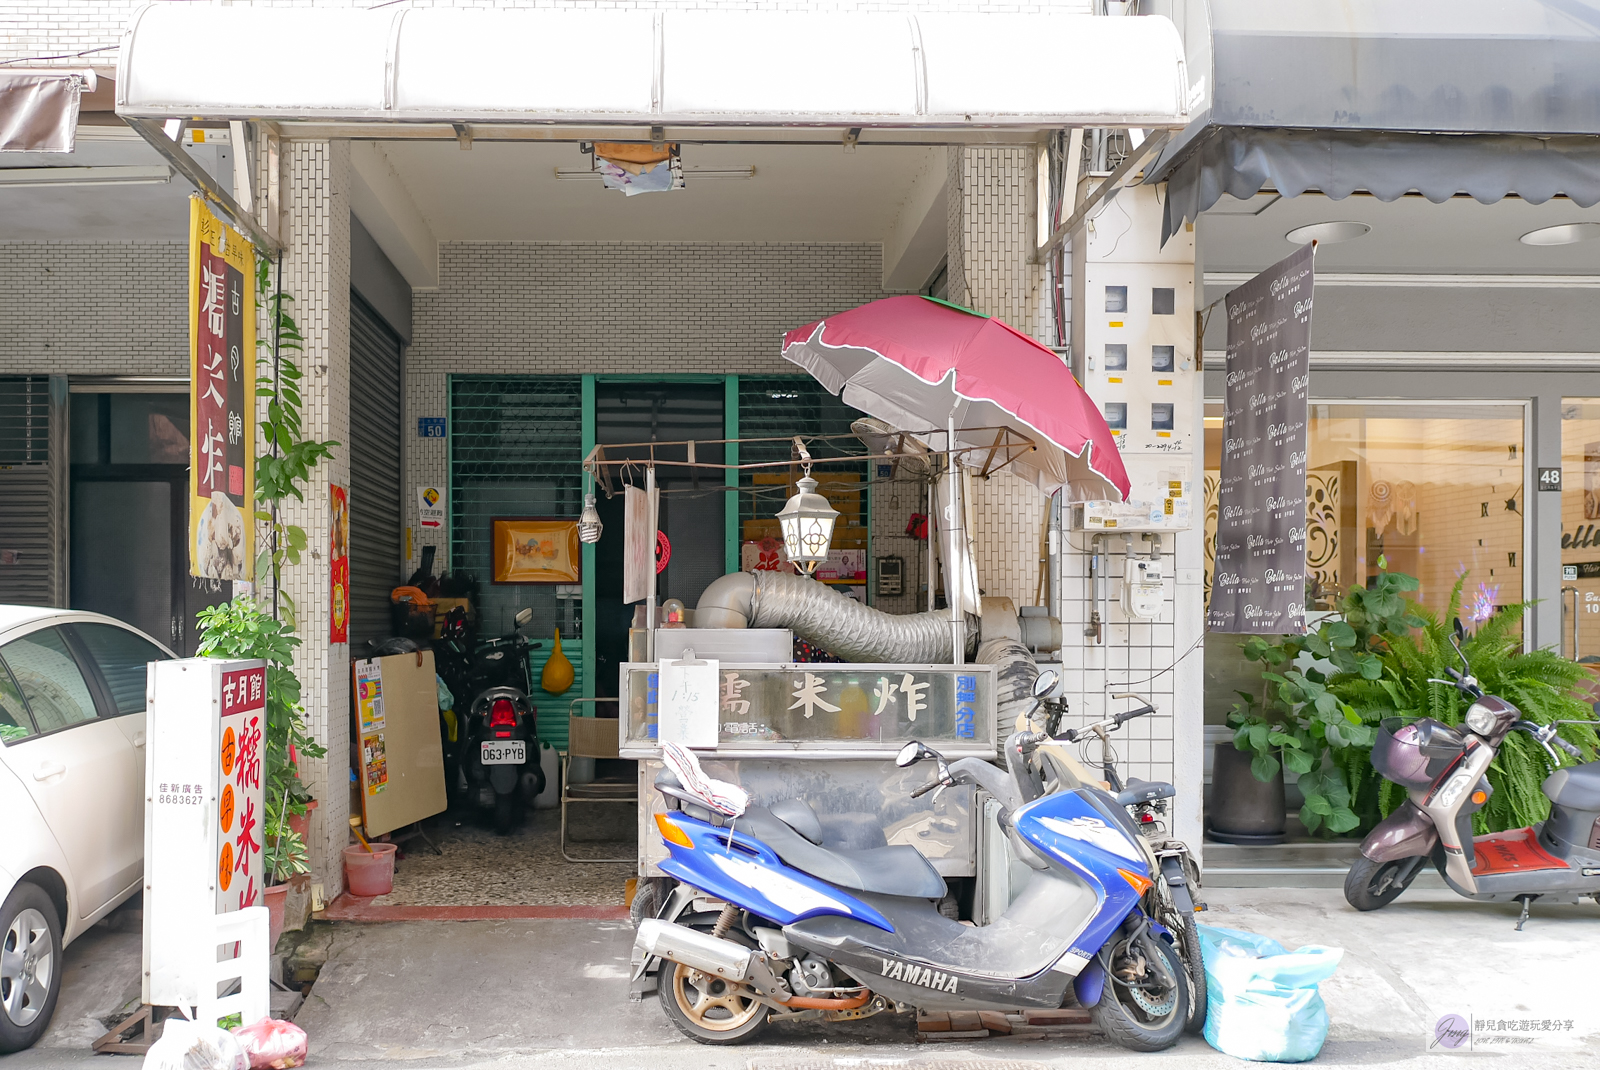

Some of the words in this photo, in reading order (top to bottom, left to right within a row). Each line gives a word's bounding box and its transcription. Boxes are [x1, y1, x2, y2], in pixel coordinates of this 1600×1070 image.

[427, 425, 442, 437] 50
[1540, 470, 1560, 484] 48
[1561, 523, 1600, 549] ell
[223, 673, 262, 709] 古月館
[159, 783, 203, 794] 佳新廣告
[159, 795, 203, 805] 8683627
[219, 733, 235, 885] 古早味
[1070, 947, 1093, 960] SPORTS
[881, 958, 958, 993] YAMAHA
